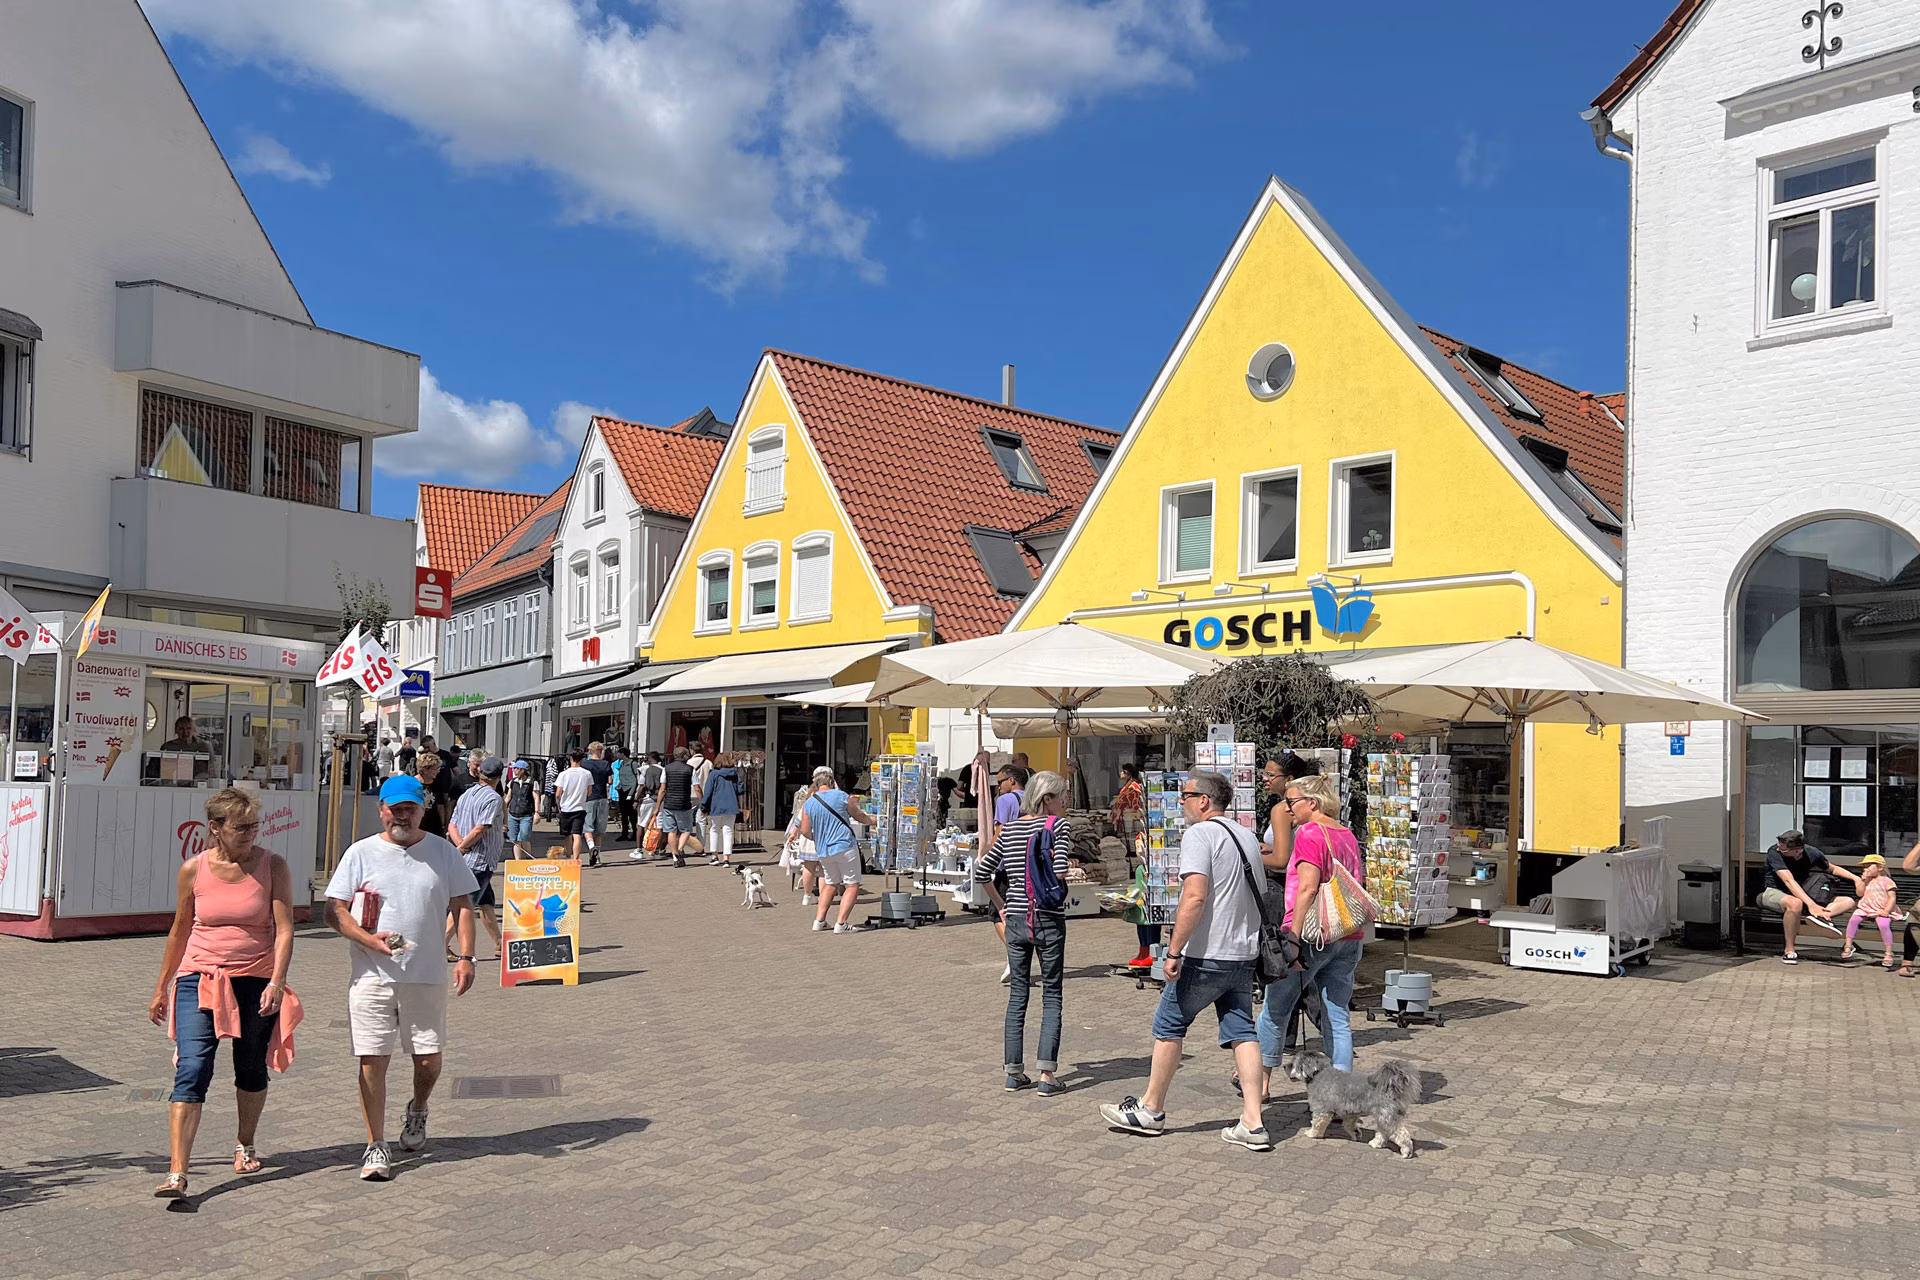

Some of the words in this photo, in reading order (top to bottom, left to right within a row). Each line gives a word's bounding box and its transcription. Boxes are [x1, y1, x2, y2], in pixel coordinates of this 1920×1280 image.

[1163, 609, 1312, 648] GOSCH
[155, 635, 226, 659] DÄNISCHES
[229, 646, 248, 661] EIS
[77, 661, 141, 678] Dänenwaffel
[75, 712, 138, 727] Tivoliwaffel
[508, 875, 561, 883] Unverfroren
[514, 881, 577, 890] LECKER!
[1525, 948, 1571, 959] GOSCH
